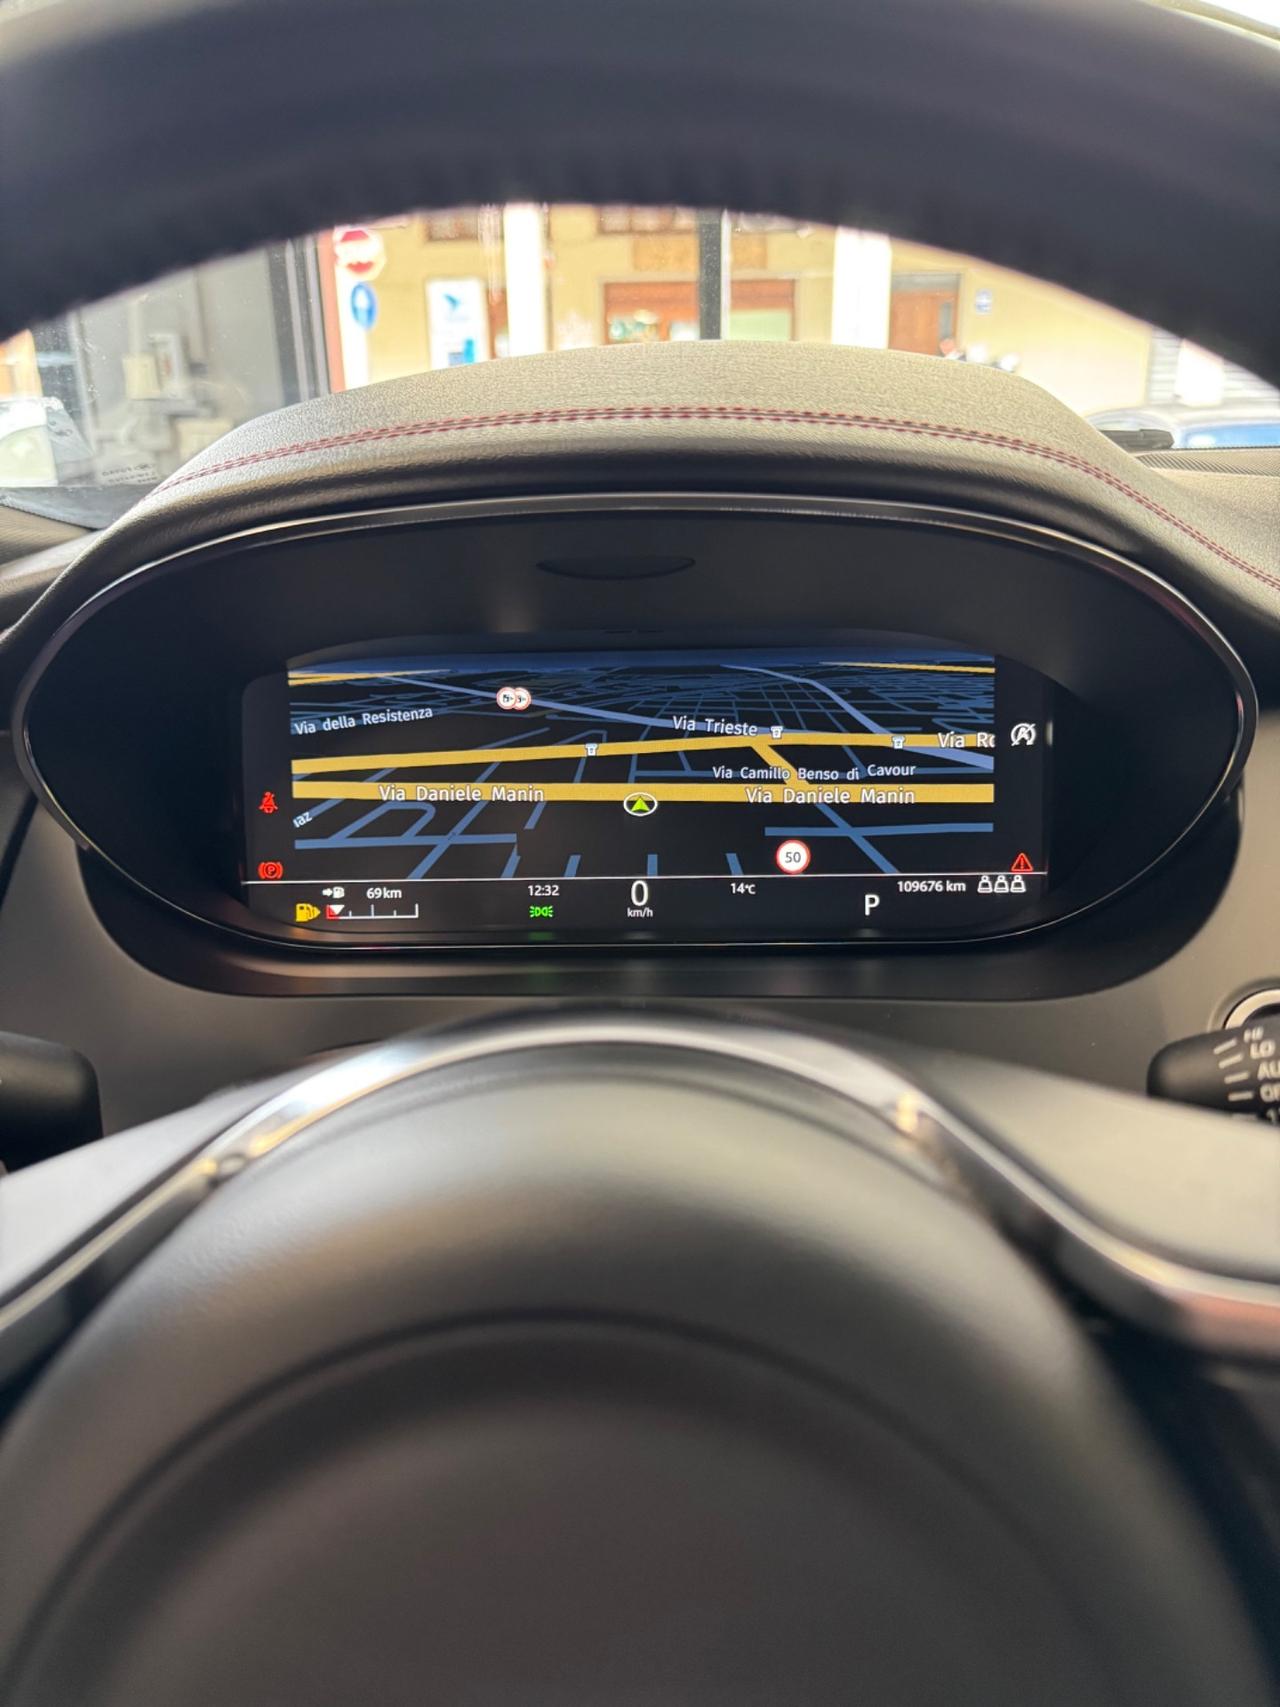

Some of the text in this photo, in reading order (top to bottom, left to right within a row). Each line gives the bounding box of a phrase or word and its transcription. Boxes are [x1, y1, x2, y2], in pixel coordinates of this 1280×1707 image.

[294, 707, 433, 735] Via della Resistenza
[673, 715, 695, 731] Via
[705, 718, 758, 736] Trieste
[938, 731, 965, 748] Via
[712, 764, 915, 780] Via Camillo Benso di Cavour
[379, 784, 545, 802] Via Daniele Manin
[745, 786, 916, 804] Via Daniele Manin
[785, 851, 802, 864] 50
[527, 884, 560, 897] 12:32
[631, 880, 649, 906] 0
[897, 880, 967, 893] 109676 km
[627, 906, 654, 918] km/h
[864, 893, 881, 917] P
